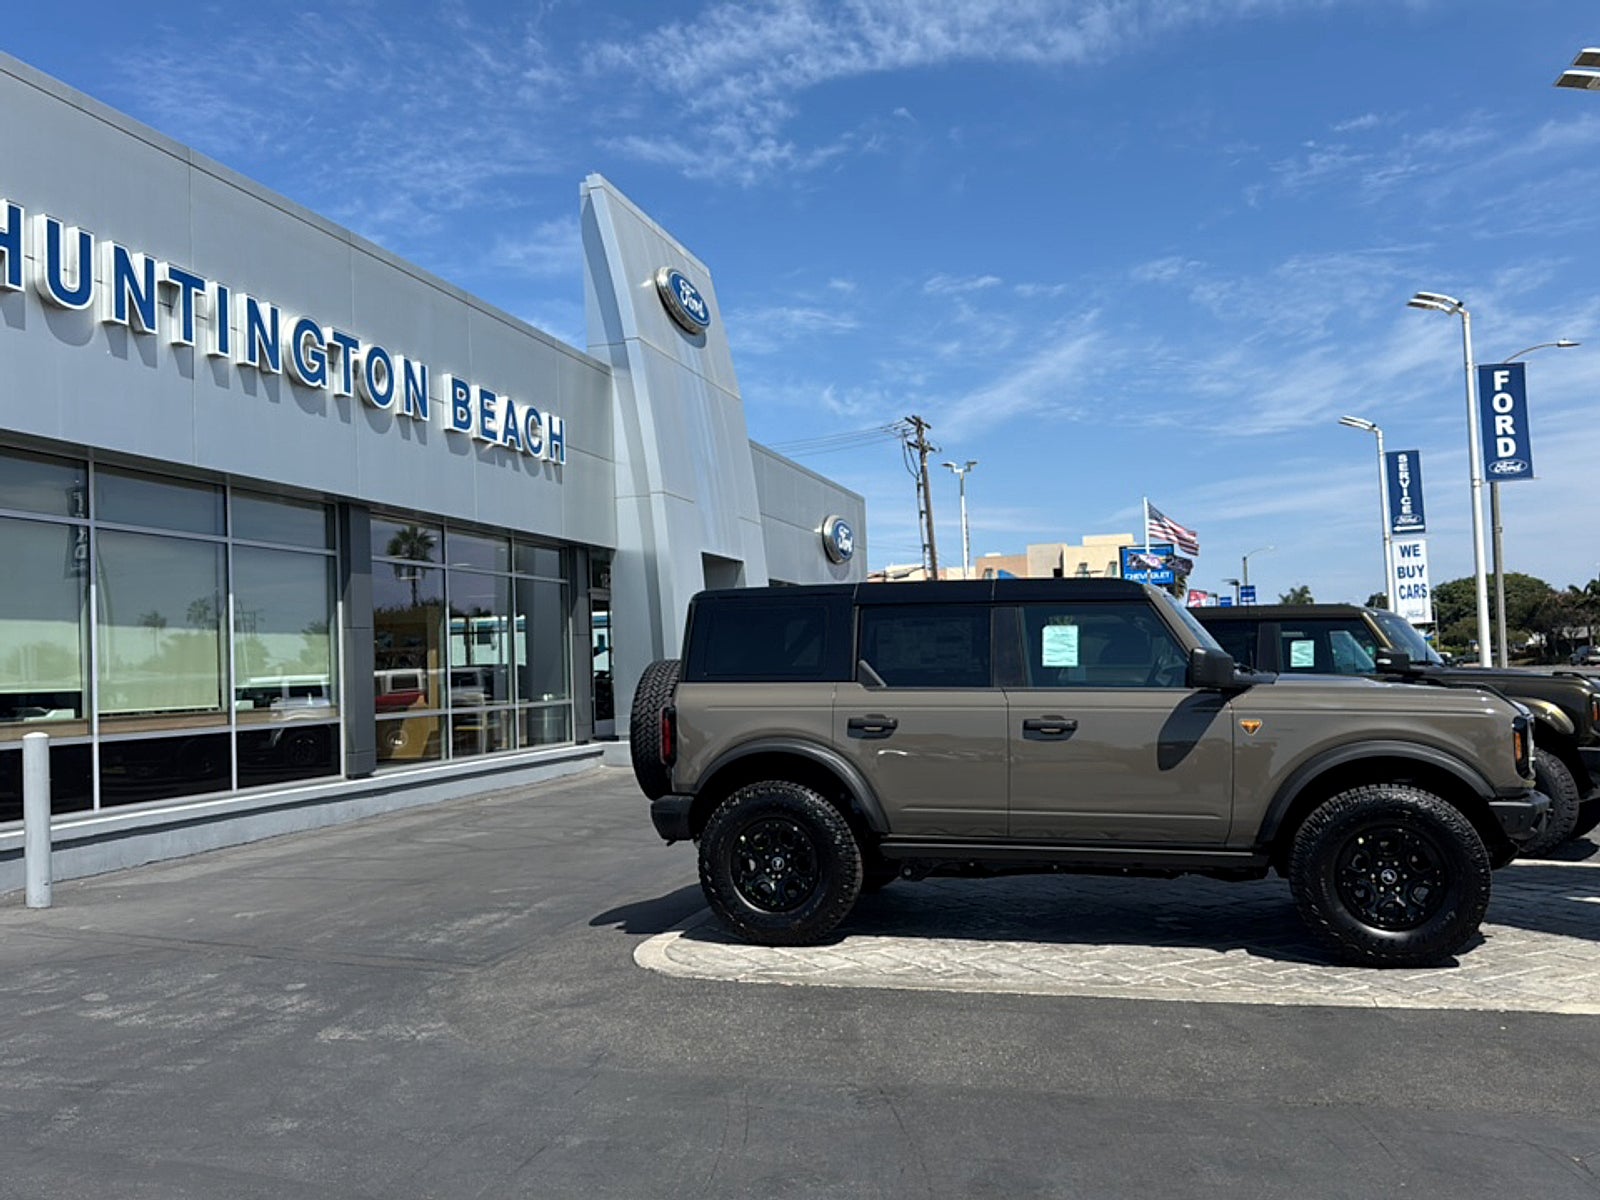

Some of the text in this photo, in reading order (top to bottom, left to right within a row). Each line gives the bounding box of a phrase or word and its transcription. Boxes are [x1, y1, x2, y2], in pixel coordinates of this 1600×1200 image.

[443, 374, 566, 464] BEACH
[1492, 370, 1516, 458] FORD
[1494, 461, 1521, 474] Ford
[1398, 454, 1412, 515] SERVICE
[1399, 544, 1421, 558] WE
[1397, 565, 1425, 580] BUY
[1399, 584, 1428, 600] CARS
